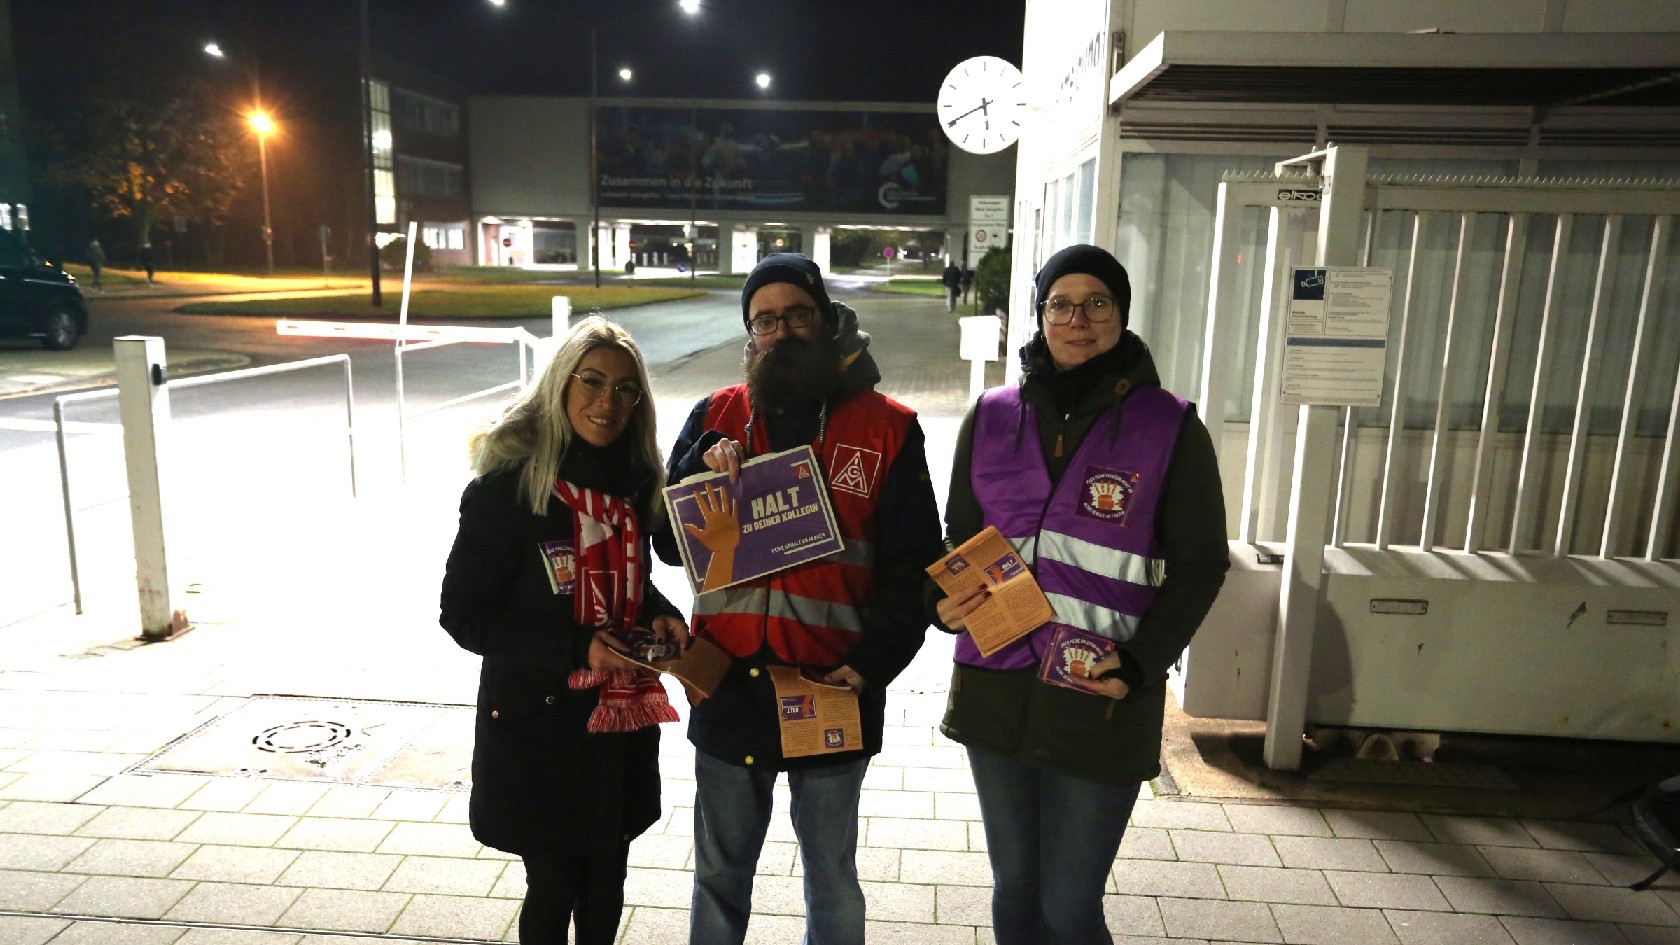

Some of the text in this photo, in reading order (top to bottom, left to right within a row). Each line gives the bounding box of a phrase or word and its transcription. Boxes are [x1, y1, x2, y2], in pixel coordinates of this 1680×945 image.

[601, 174, 667, 187] Zusammen
[670, 175, 681, 187] in
[705, 175, 753, 188] Zukunft
[742, 502, 819, 534] ZU DEINER KOLLEGIN
[751, 486, 800, 520] HALT
